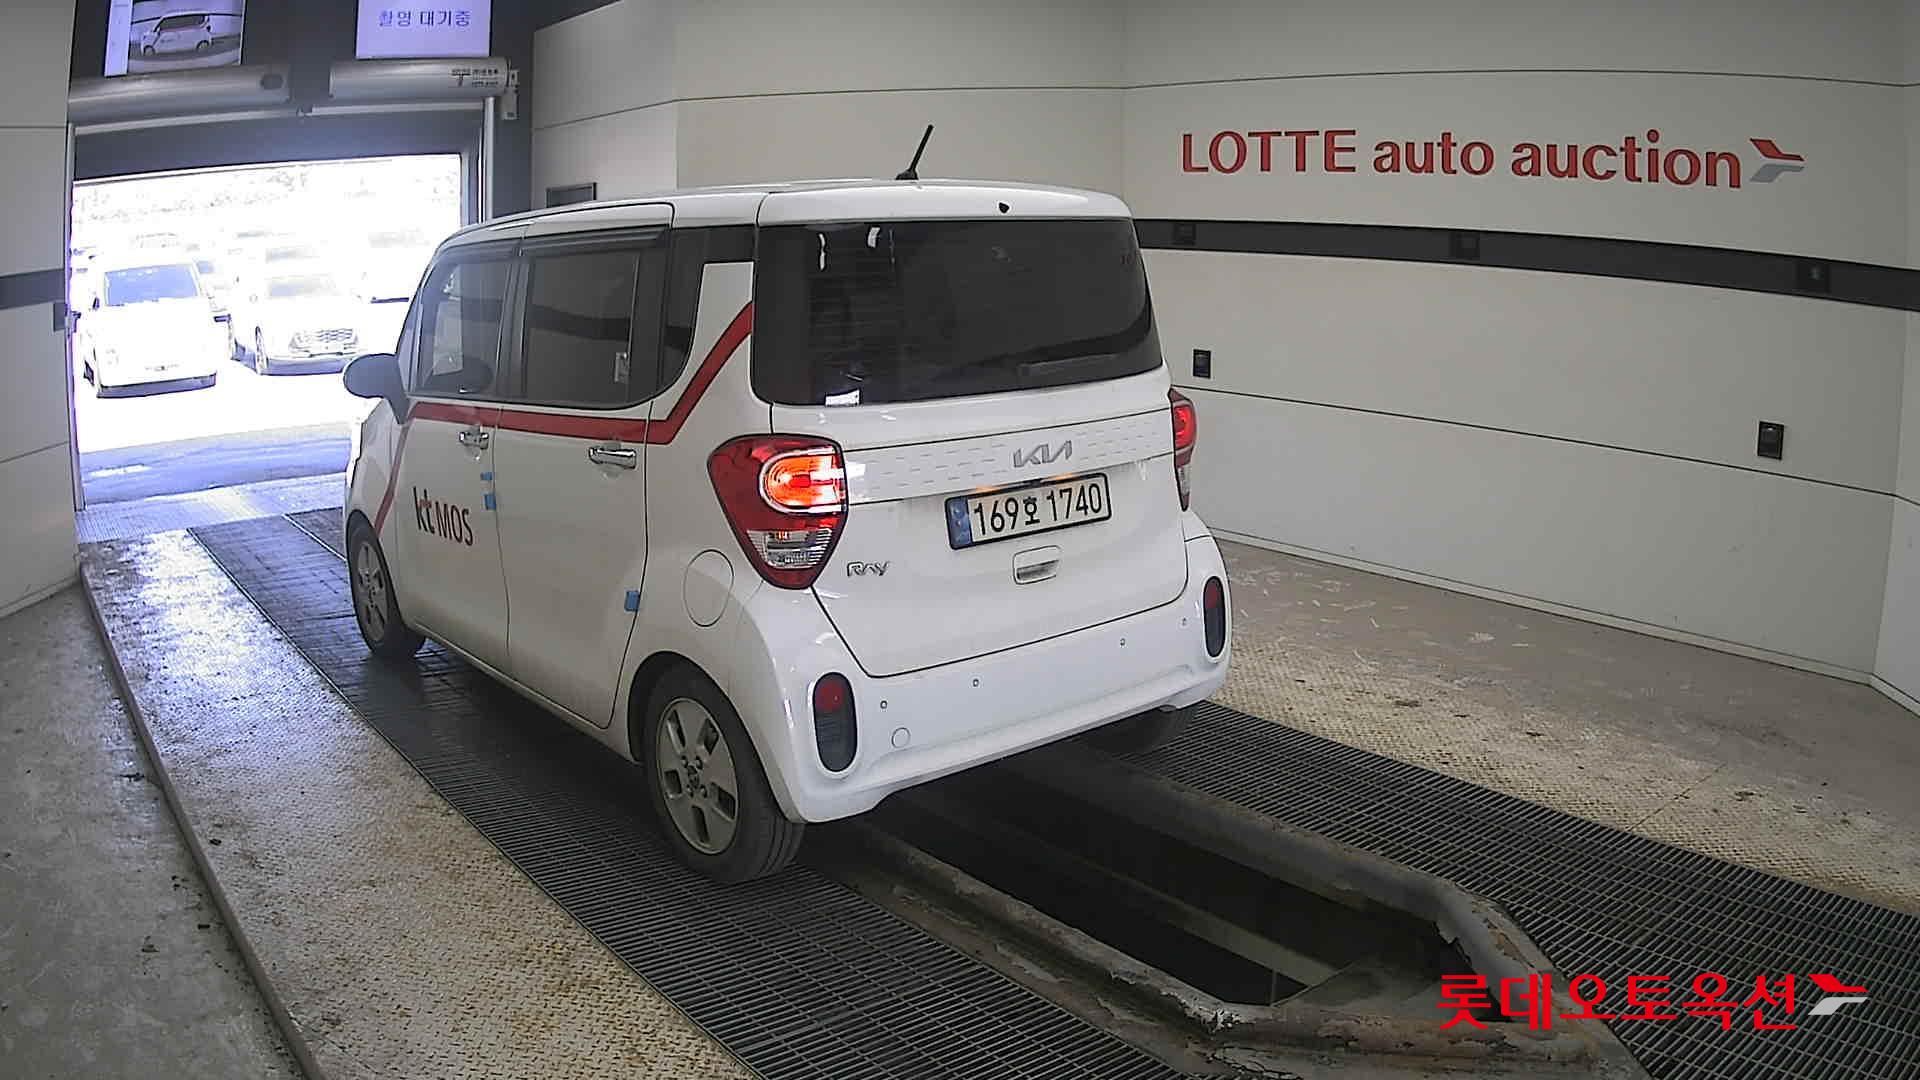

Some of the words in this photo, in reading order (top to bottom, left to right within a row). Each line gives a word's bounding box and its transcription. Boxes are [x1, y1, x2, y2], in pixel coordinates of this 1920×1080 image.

[420, 10, 471, 27] 대기중
[1182, 129, 1357, 174] LOTTE
[1373, 131, 1495, 176] auto
[1511, 129, 1742, 189] auction
[413, 486, 435, 535] kt
[435, 501, 474, 547] MOS
[973, 496, 1041, 536] 169호
[1047, 482, 1102, 522] 1740
